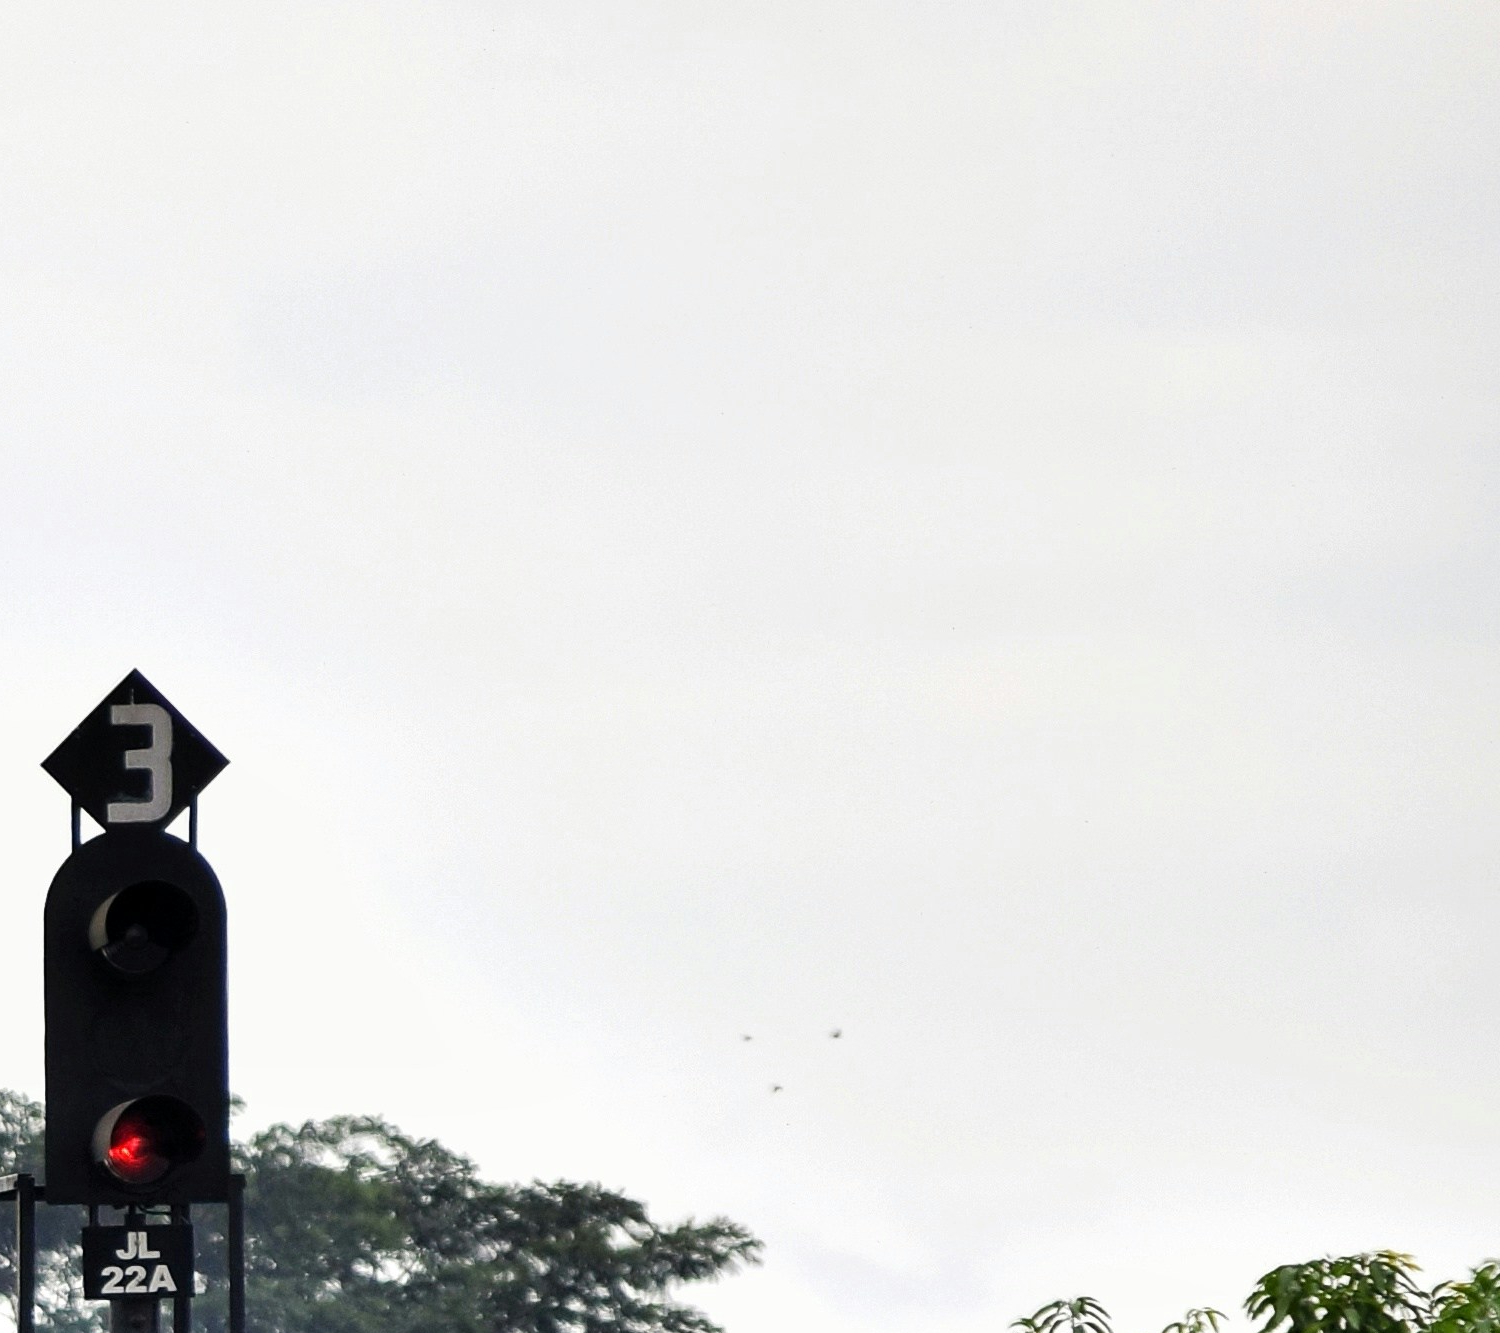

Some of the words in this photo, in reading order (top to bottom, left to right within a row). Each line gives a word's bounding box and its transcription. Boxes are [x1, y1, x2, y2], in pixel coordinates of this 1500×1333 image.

[107, 703, 173, 822] 3
[115, 1231, 161, 1260] JL
[101, 1264, 178, 1294] 22A
